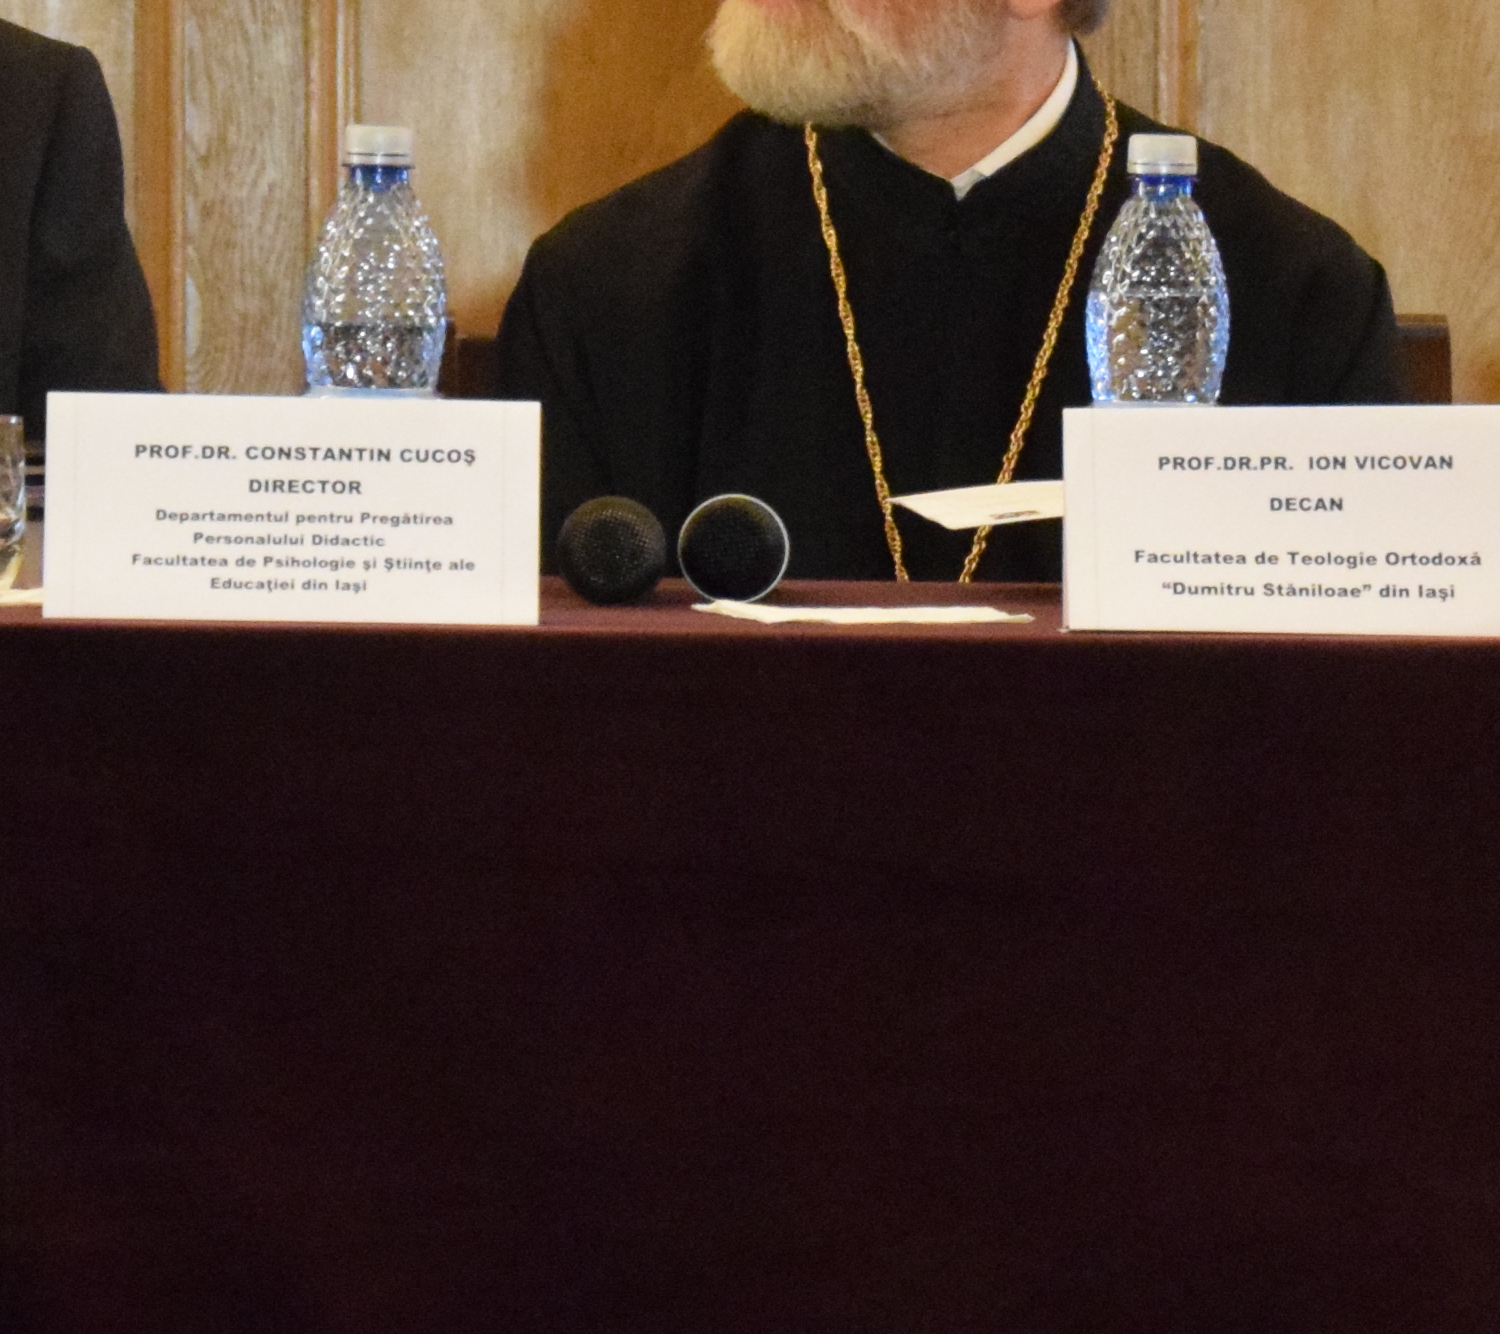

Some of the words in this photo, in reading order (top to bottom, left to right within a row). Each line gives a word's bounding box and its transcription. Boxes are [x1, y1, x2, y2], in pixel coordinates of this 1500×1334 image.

[133, 442, 238, 461] PROF.DR.
[243, 444, 393, 464] CONSTANTIN
[1156, 454, 1295, 473] PROF.DR.PR.
[1307, 454, 1348, 472] ION
[1353, 453, 1455, 472] VICOVAN
[247, 477, 363, 496] DIRECTOR
[1268, 495, 1345, 513] DECAN
[154, 507, 290, 525] Departamentul
[294, 511, 355, 527] pentru
[192, 530, 306, 547] Personalului
[310, 532, 386, 548] Didactic
[130, 552, 230, 568] Facultatea
[233, 554, 258, 569] de
[261, 554, 357, 573] Psihologie
[447, 557, 477, 573] ale
[1132, 548, 1248, 566] Facultatea
[1253, 549, 1281, 567] de
[1285, 550, 1379, 571] Teologie
[300, 577, 330, 592] din
[1377, 583, 1411, 600] din
